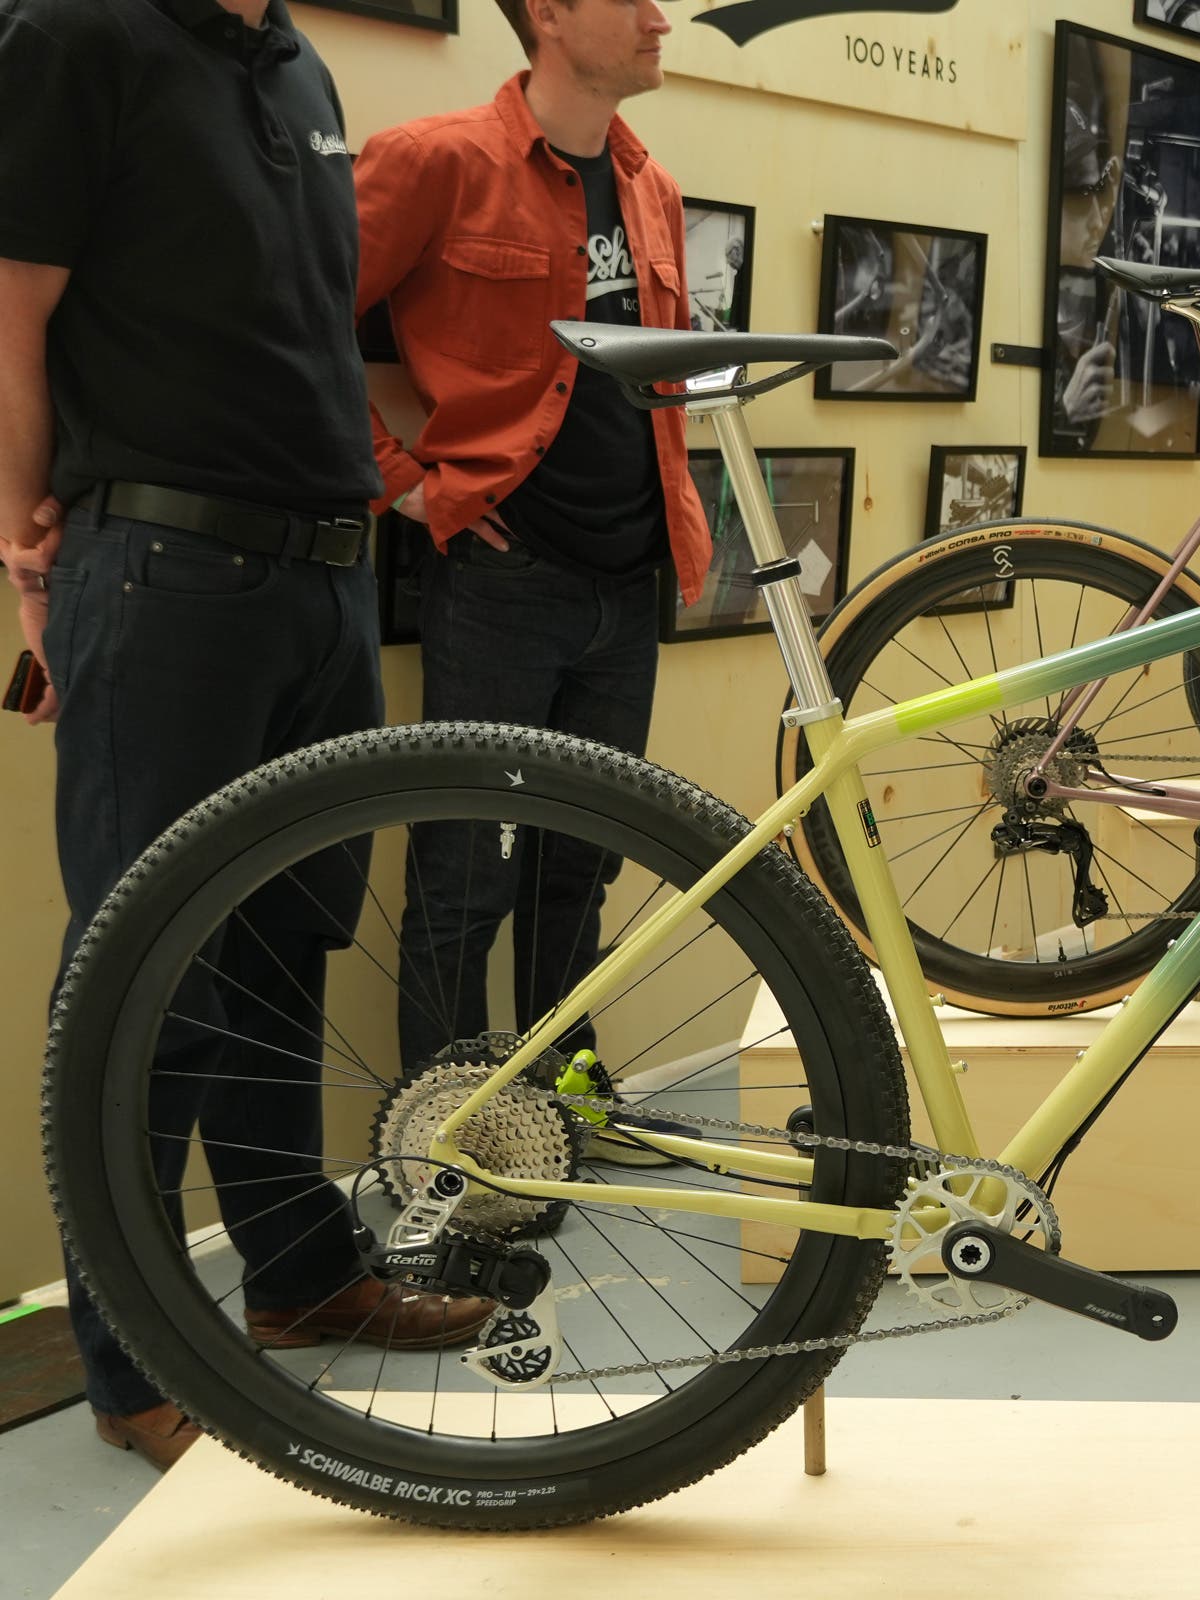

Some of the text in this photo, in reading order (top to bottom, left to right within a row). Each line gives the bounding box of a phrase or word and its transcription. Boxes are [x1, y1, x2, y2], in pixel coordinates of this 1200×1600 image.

[845, 35, 957, 84] 100 YEARS
[948, 535, 986, 550] CORSA
[988, 530, 1012, 539] PRO
[385, 1254, 437, 1266] Ratio
[299, 1448, 394, 1494] SCHWALBE
[392, 1480, 446, 1504] RICK
[443, 1488, 473, 1507] XC
[476, 1490, 494, 1499] PRO
[504, 1490, 518, 1499] TLR
[476, 1498, 517, 1507] SPEEDGRIP
